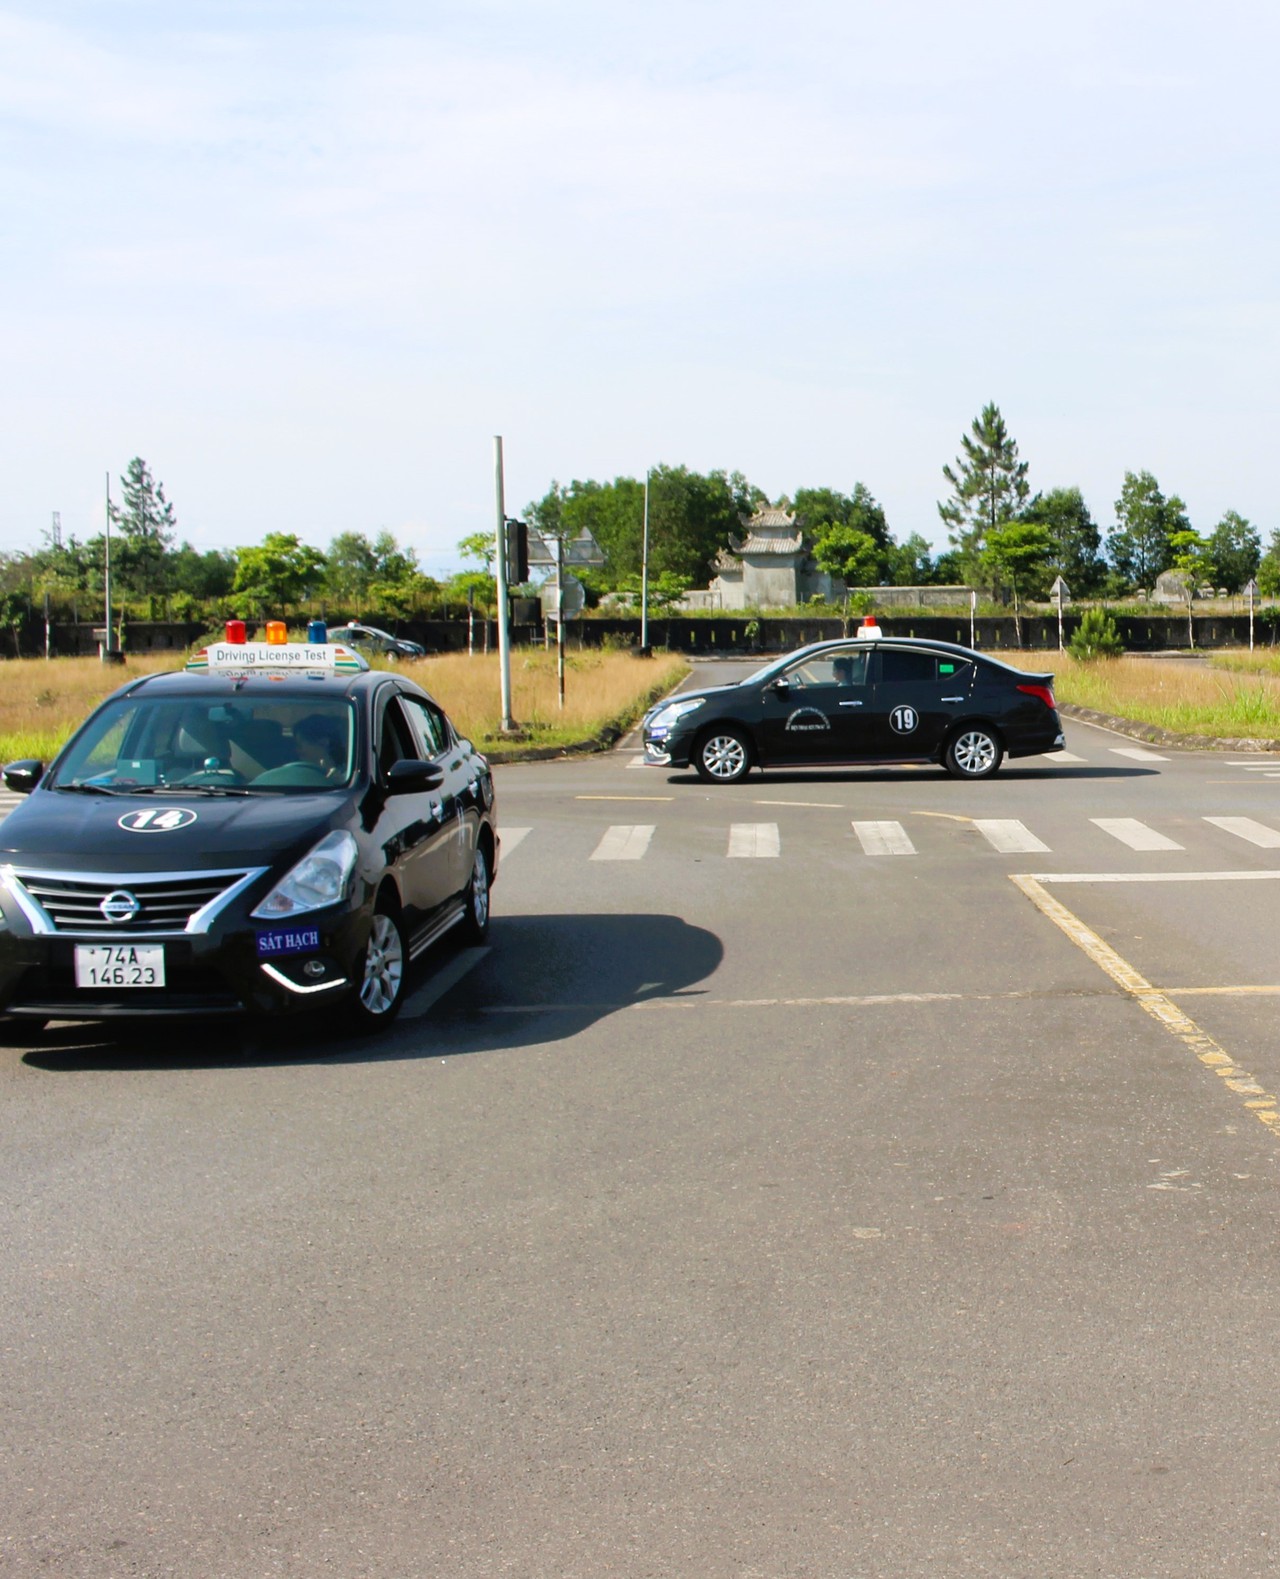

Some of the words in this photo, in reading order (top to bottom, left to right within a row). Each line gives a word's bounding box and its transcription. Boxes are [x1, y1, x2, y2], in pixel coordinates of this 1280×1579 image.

[216, 650, 256, 662] Driving
[259, 650, 301, 661] License
[304, 649, 327, 661] Test
[895, 709, 914, 729] 19
[132, 810, 183, 828] 14
[258, 934, 283, 951] SÁT
[285, 931, 318, 951] HẠCH
[102, 947, 139, 965] 74A
[89, 967, 155, 985] 146.23
